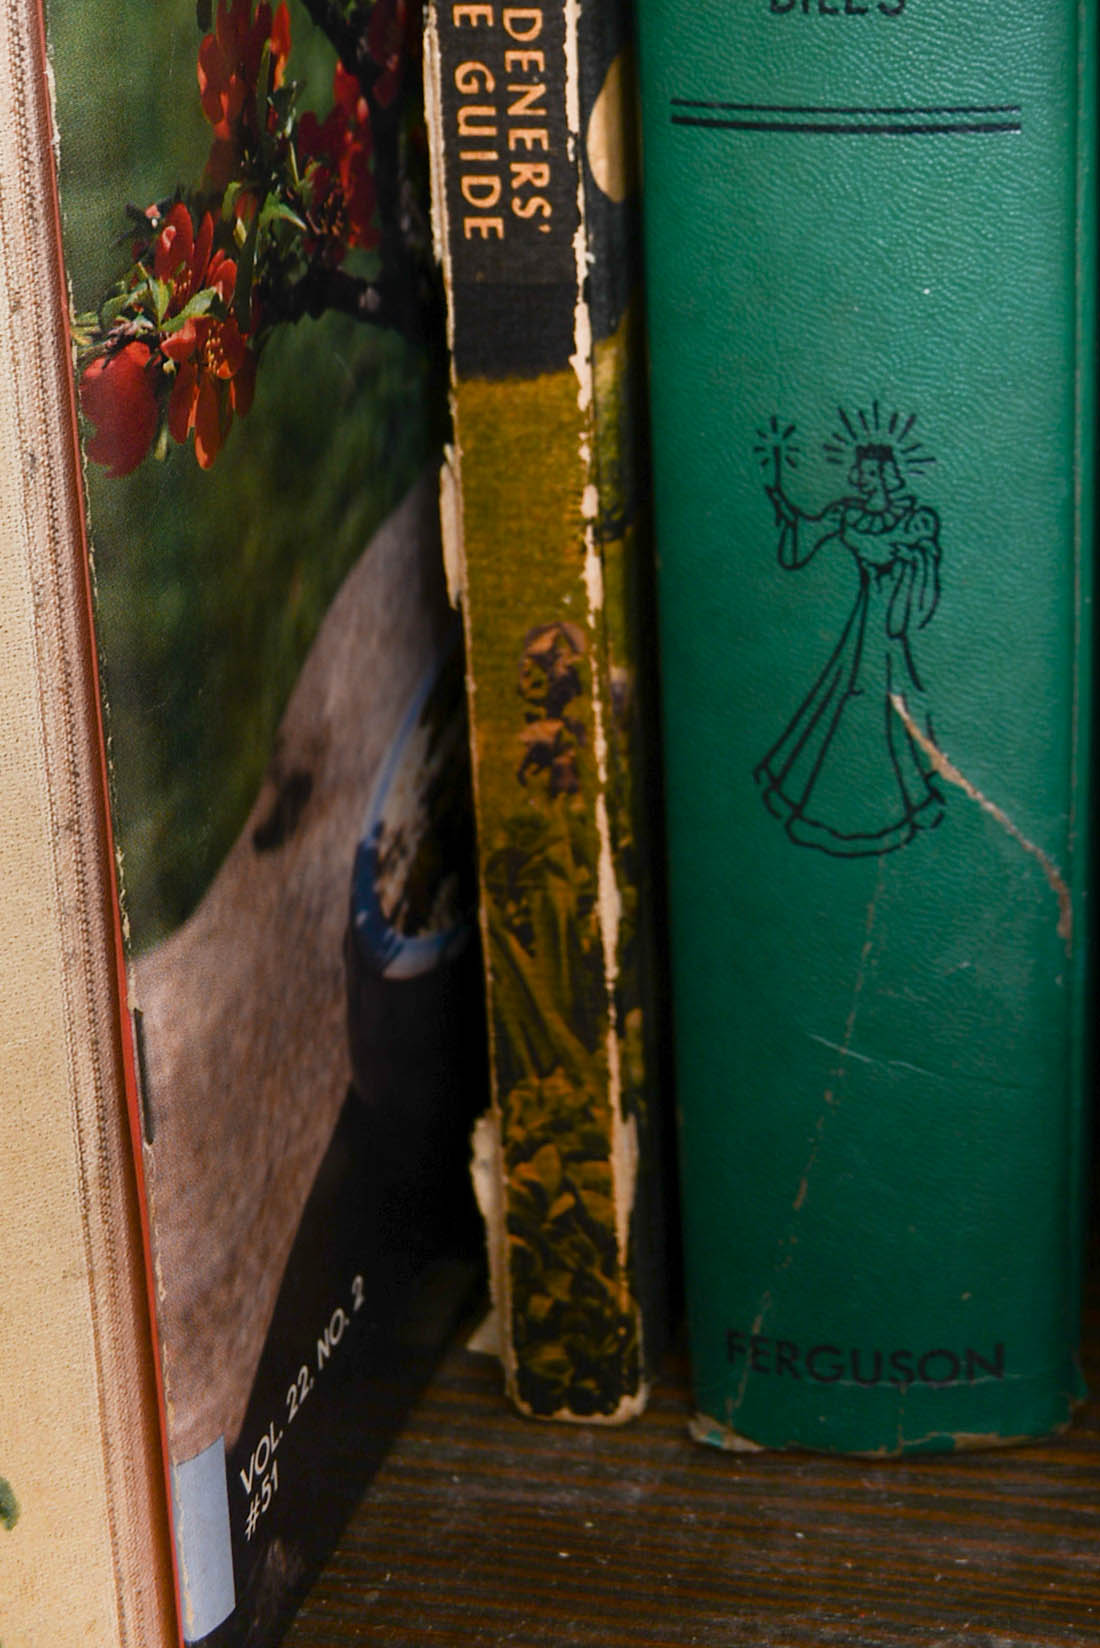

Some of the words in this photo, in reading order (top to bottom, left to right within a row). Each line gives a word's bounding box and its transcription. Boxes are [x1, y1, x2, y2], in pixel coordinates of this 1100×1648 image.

[453, 60, 506, 241] GUIDE
[240, 1421, 283, 1495] VOL.
[316, 1308, 350, 1371] NO.
[351, 1274, 366, 1311] 2
[725, 1329, 1005, 1386] FERGUSON
[246, 1459, 280, 1542] #51
